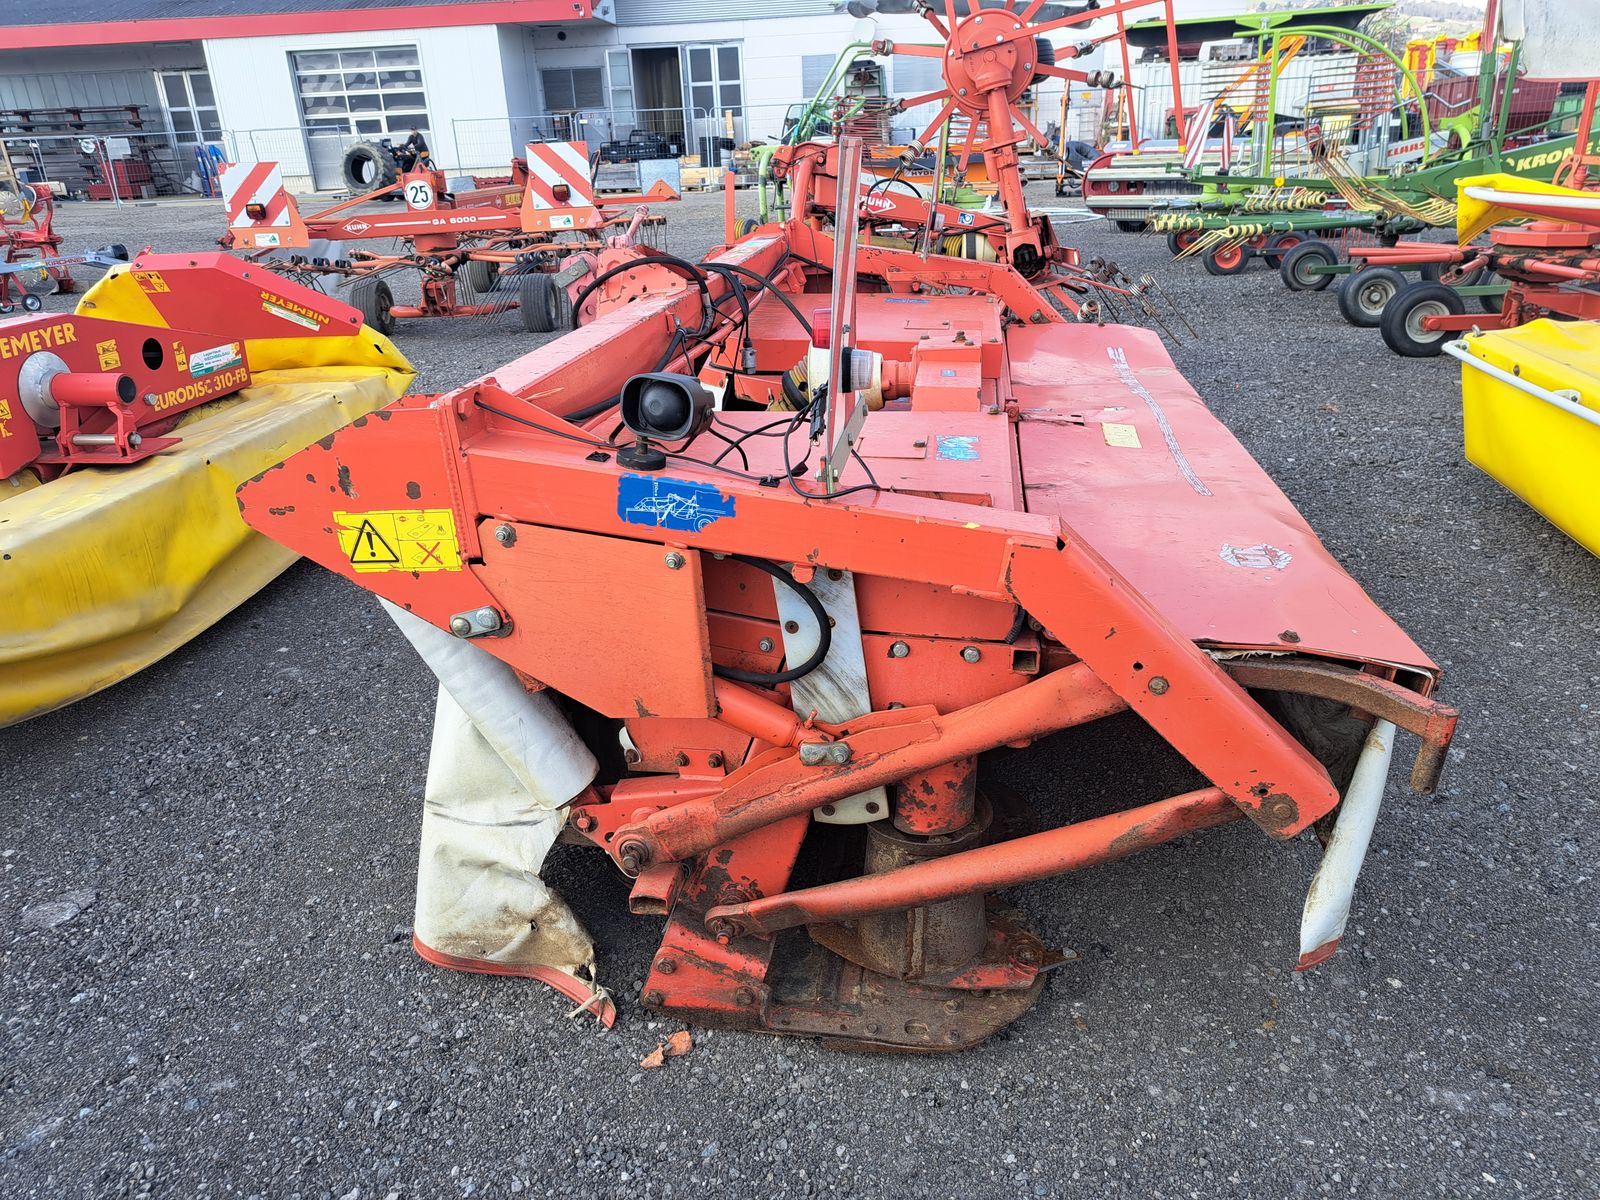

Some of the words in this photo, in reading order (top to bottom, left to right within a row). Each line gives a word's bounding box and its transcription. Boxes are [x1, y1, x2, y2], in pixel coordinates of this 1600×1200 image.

[1387, 141, 1425, 157] CLAAS
[409, 185, 429, 204] 25
[346, 223, 368, 231] KUHN
[450, 215, 477, 225] 6000
[260, 290, 330, 325] NIEMEYER
[214, 367, 248, 391] 310-FB
